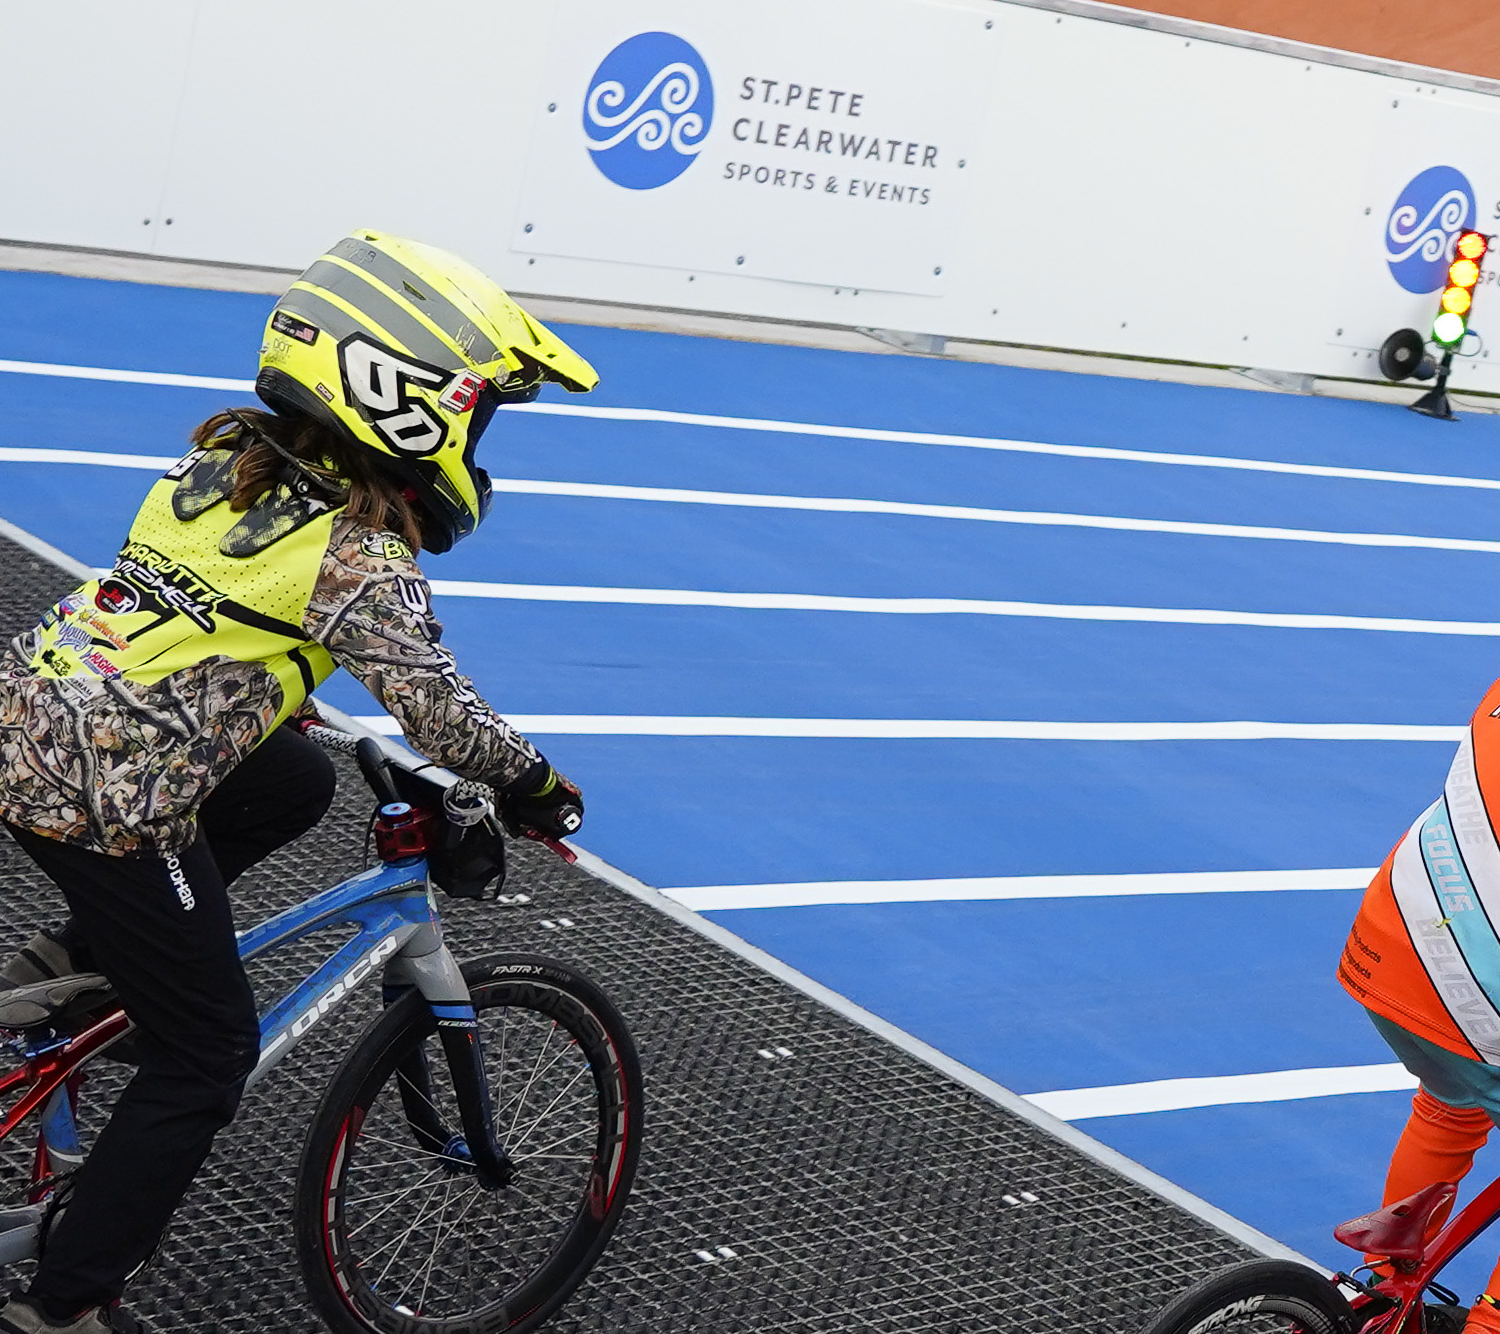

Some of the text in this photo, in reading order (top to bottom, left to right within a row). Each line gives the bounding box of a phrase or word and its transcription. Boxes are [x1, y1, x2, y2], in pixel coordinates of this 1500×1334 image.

[739, 74, 866, 118] ST.PETE
[731, 117, 940, 170] CLEARWATER
[722, 161, 932, 206] SPORTS & EVENTS
[1425, 822, 1476, 913] FOCUS
[1414, 914, 1500, 1036] BELIEVE
